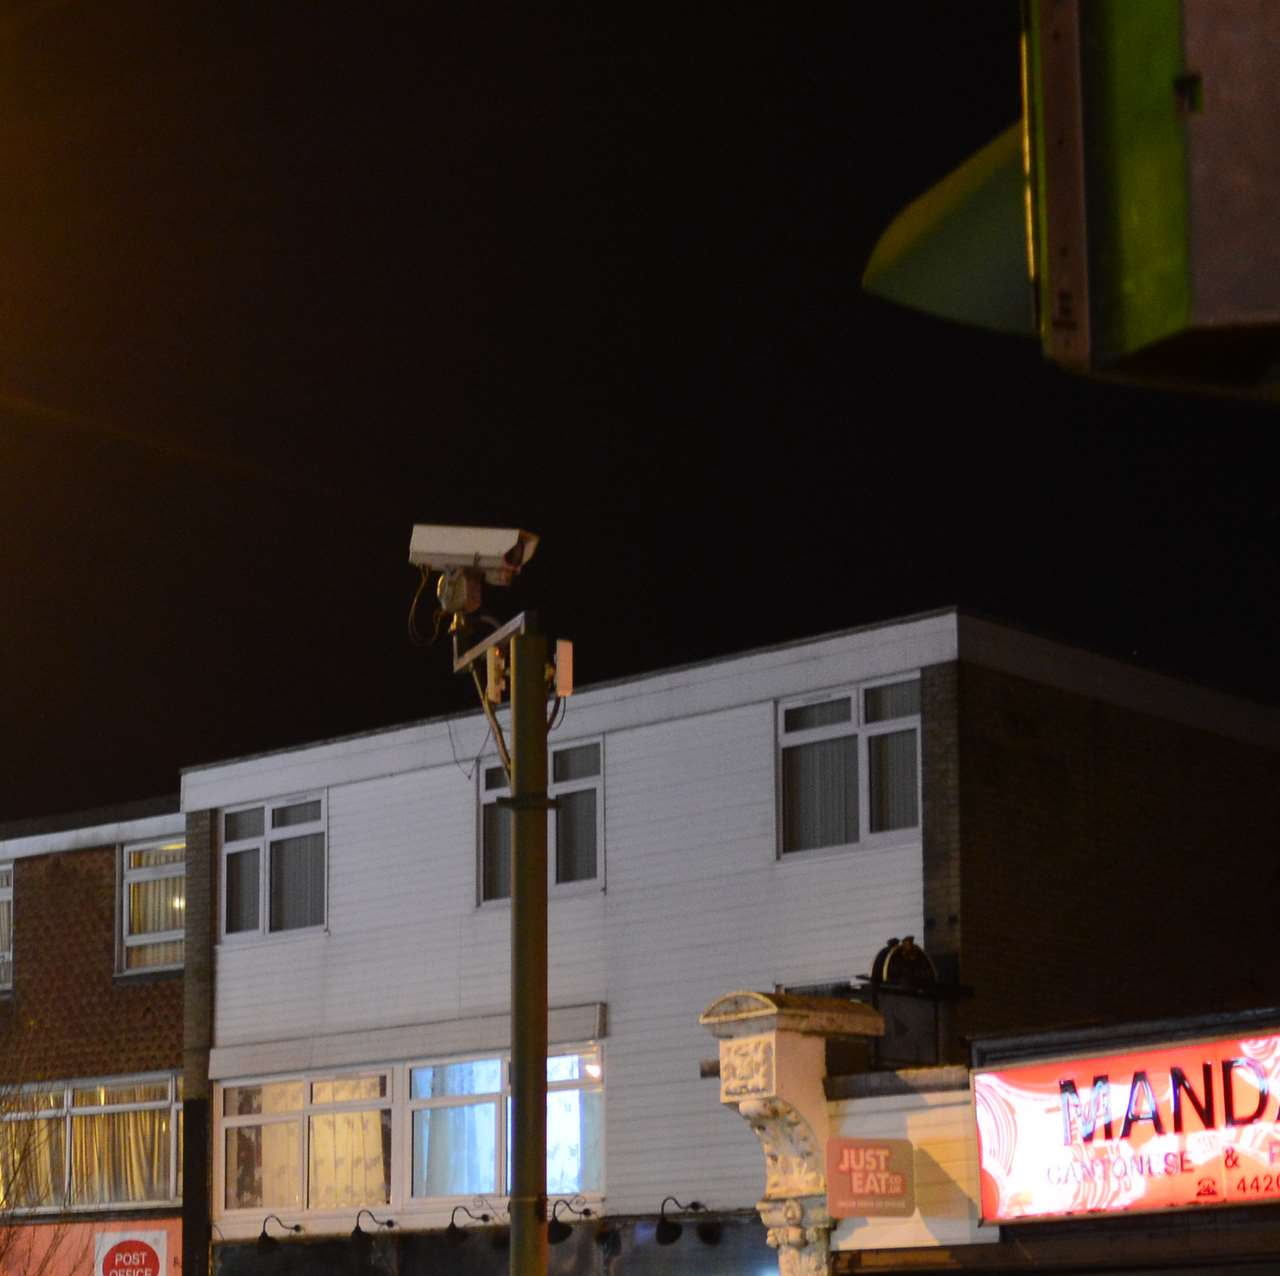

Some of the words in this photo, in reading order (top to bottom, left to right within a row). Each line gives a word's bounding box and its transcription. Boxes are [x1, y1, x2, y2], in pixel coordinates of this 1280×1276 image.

[1058, 1058, 1280, 1146] MAND
[839, 1148, 889, 1171] JUST
[1046, 1150, 1195, 1186] CANTONESE
[1224, 1146, 1239, 1169] &
[851, 1172, 889, 1193] EAT
[114, 1251, 148, 1266] POST
